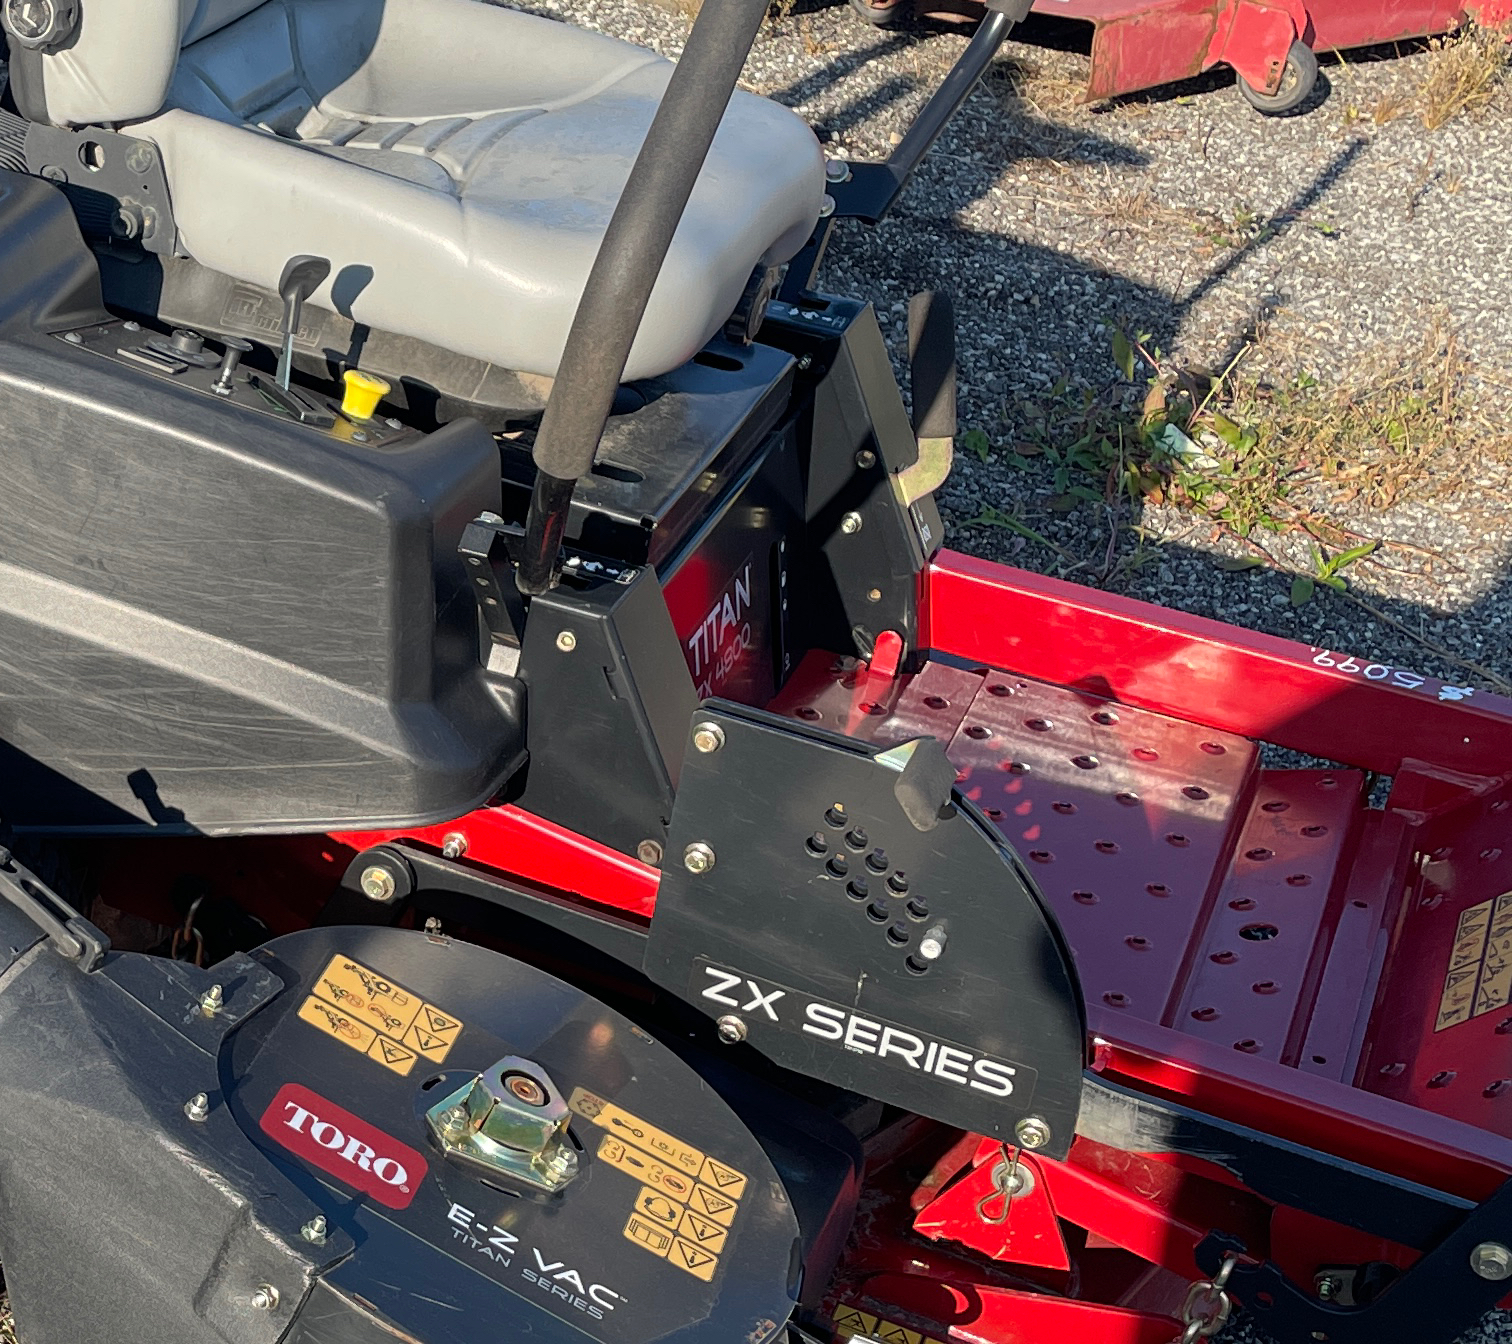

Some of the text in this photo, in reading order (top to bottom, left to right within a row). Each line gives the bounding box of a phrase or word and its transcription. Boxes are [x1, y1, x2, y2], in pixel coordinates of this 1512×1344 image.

[688, 564, 751, 677] TITAN
[701, 966, 1016, 1097] ZX SERIES
[283, 1100, 409, 1186] TORO
[447, 1202, 620, 1311] E-Z VAC
[451, 1226, 604, 1320] TITAN SERIES
